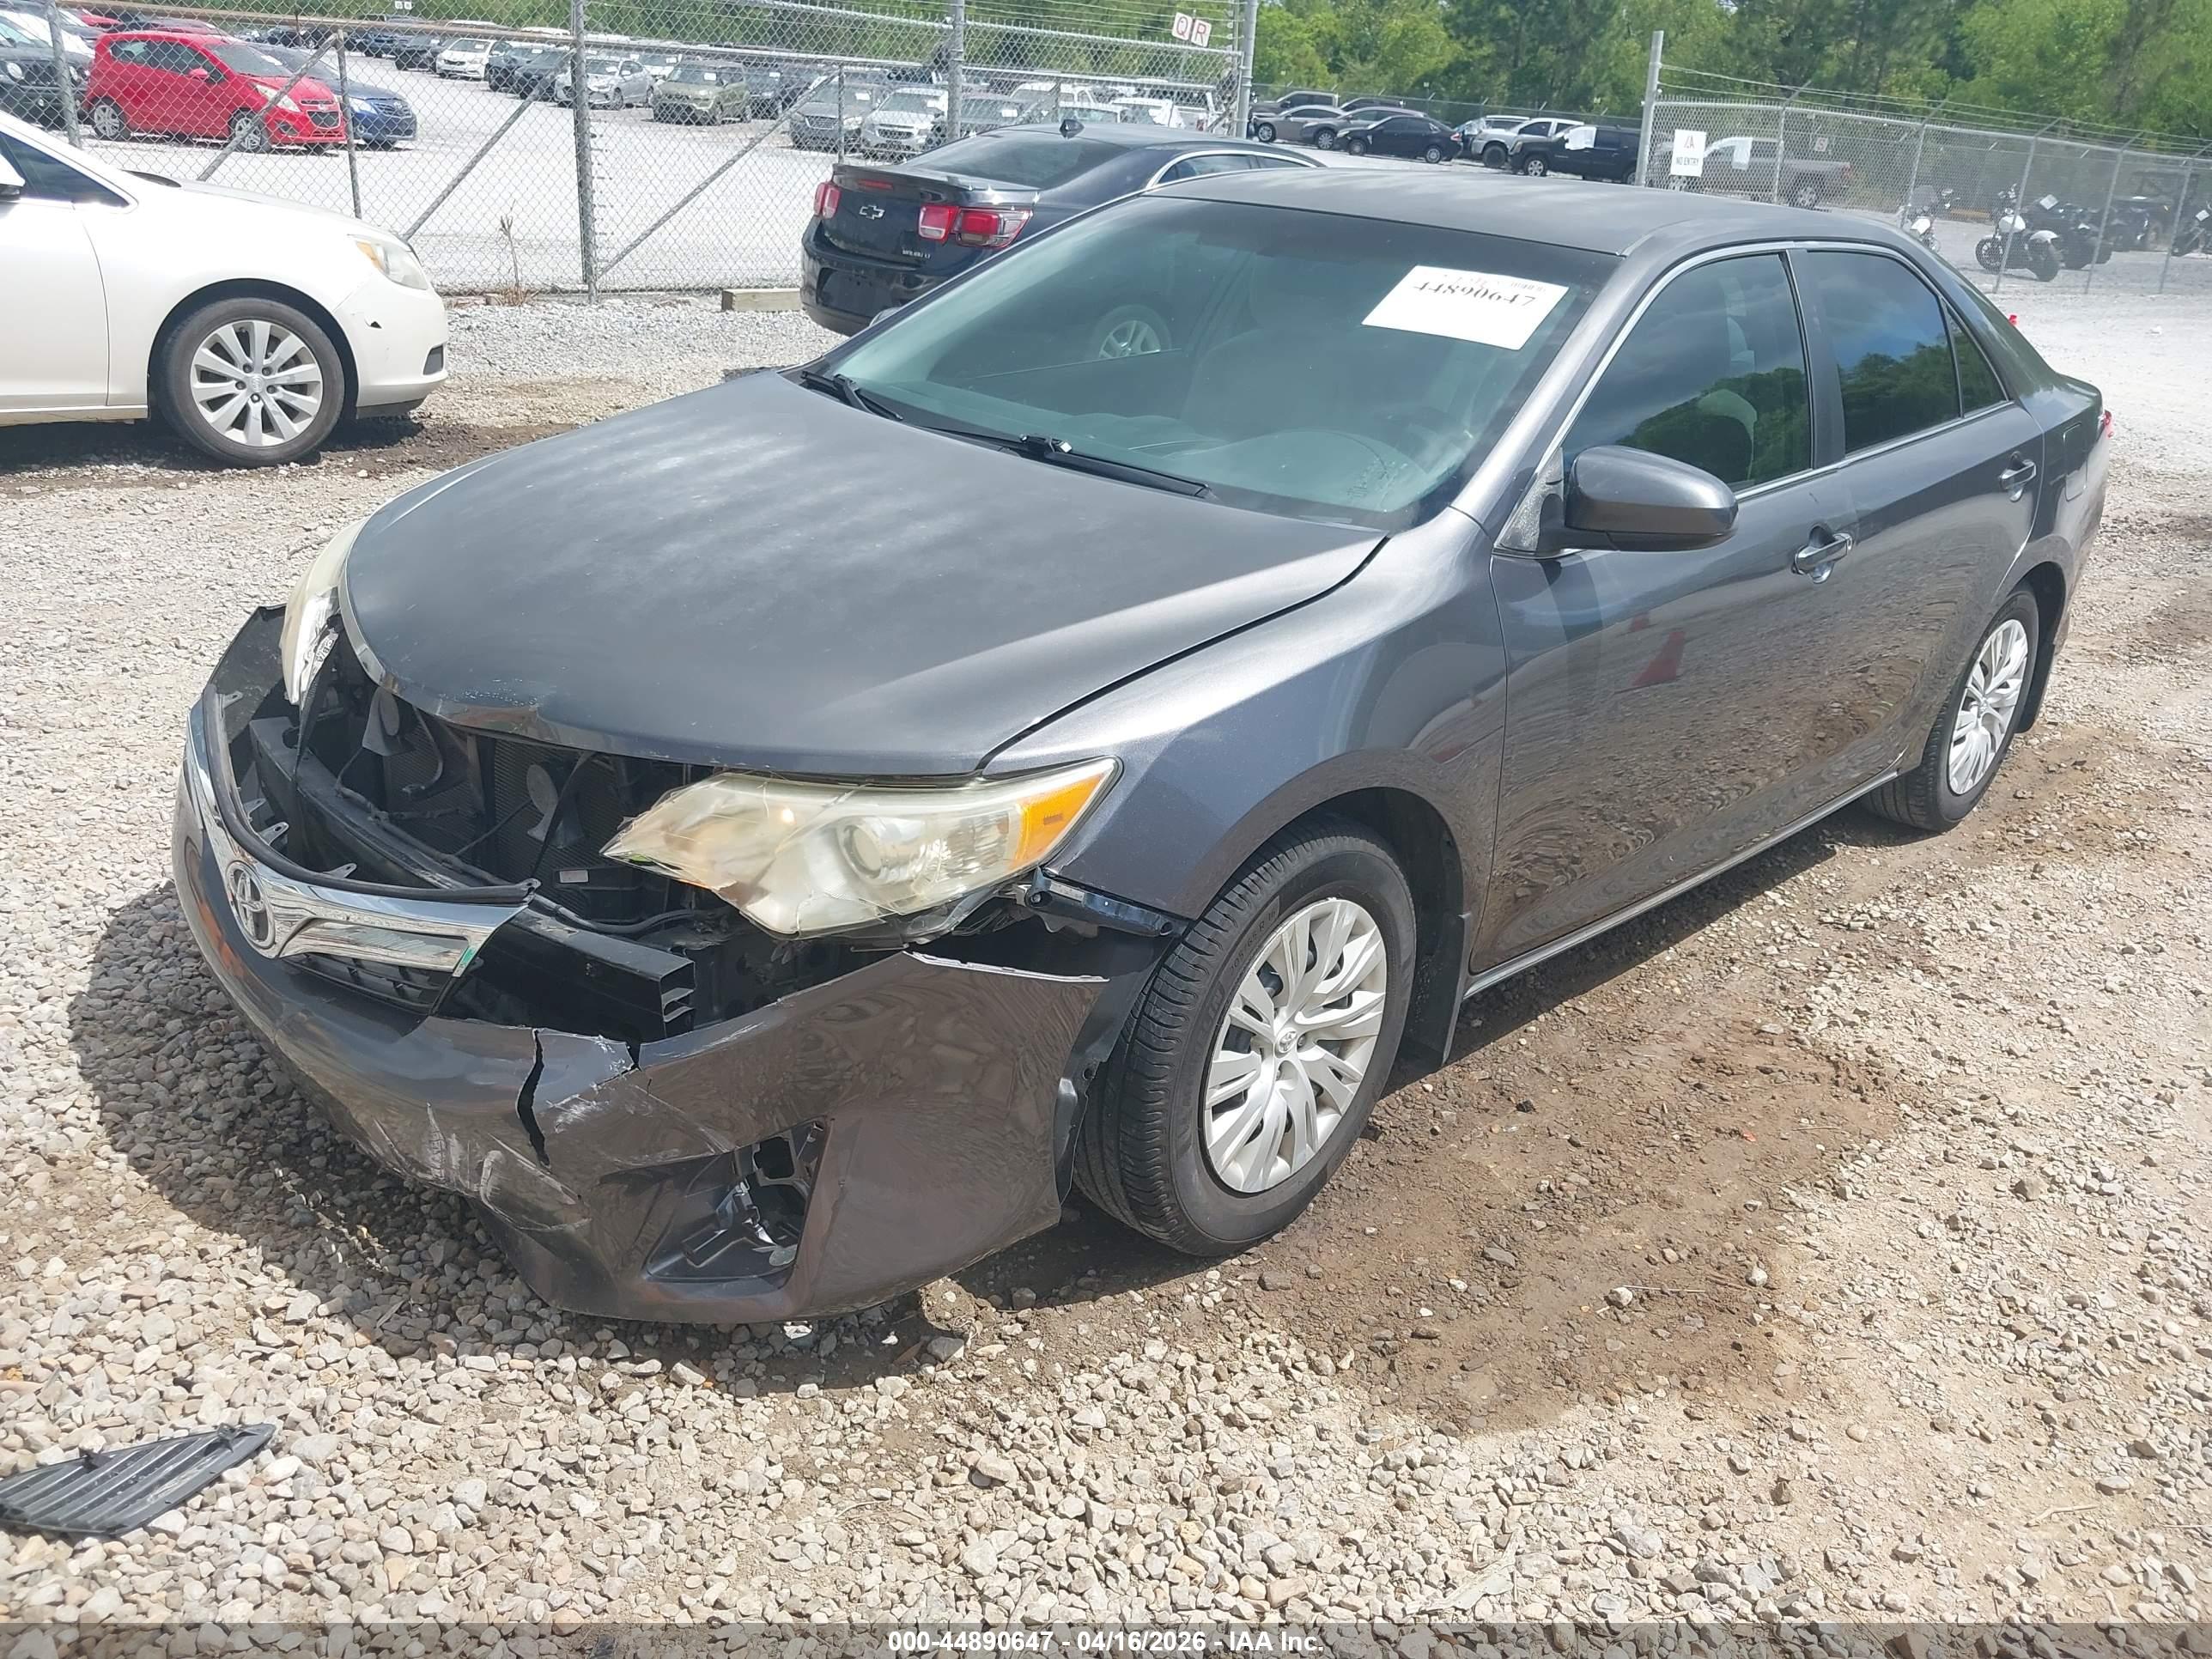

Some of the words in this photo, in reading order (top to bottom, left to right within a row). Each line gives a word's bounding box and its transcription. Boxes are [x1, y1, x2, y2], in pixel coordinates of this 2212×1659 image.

[1177, 16, 1188, 39] Q
[1194, 22, 1206, 44] R
[1413, 281, 1536, 307] 44890647
